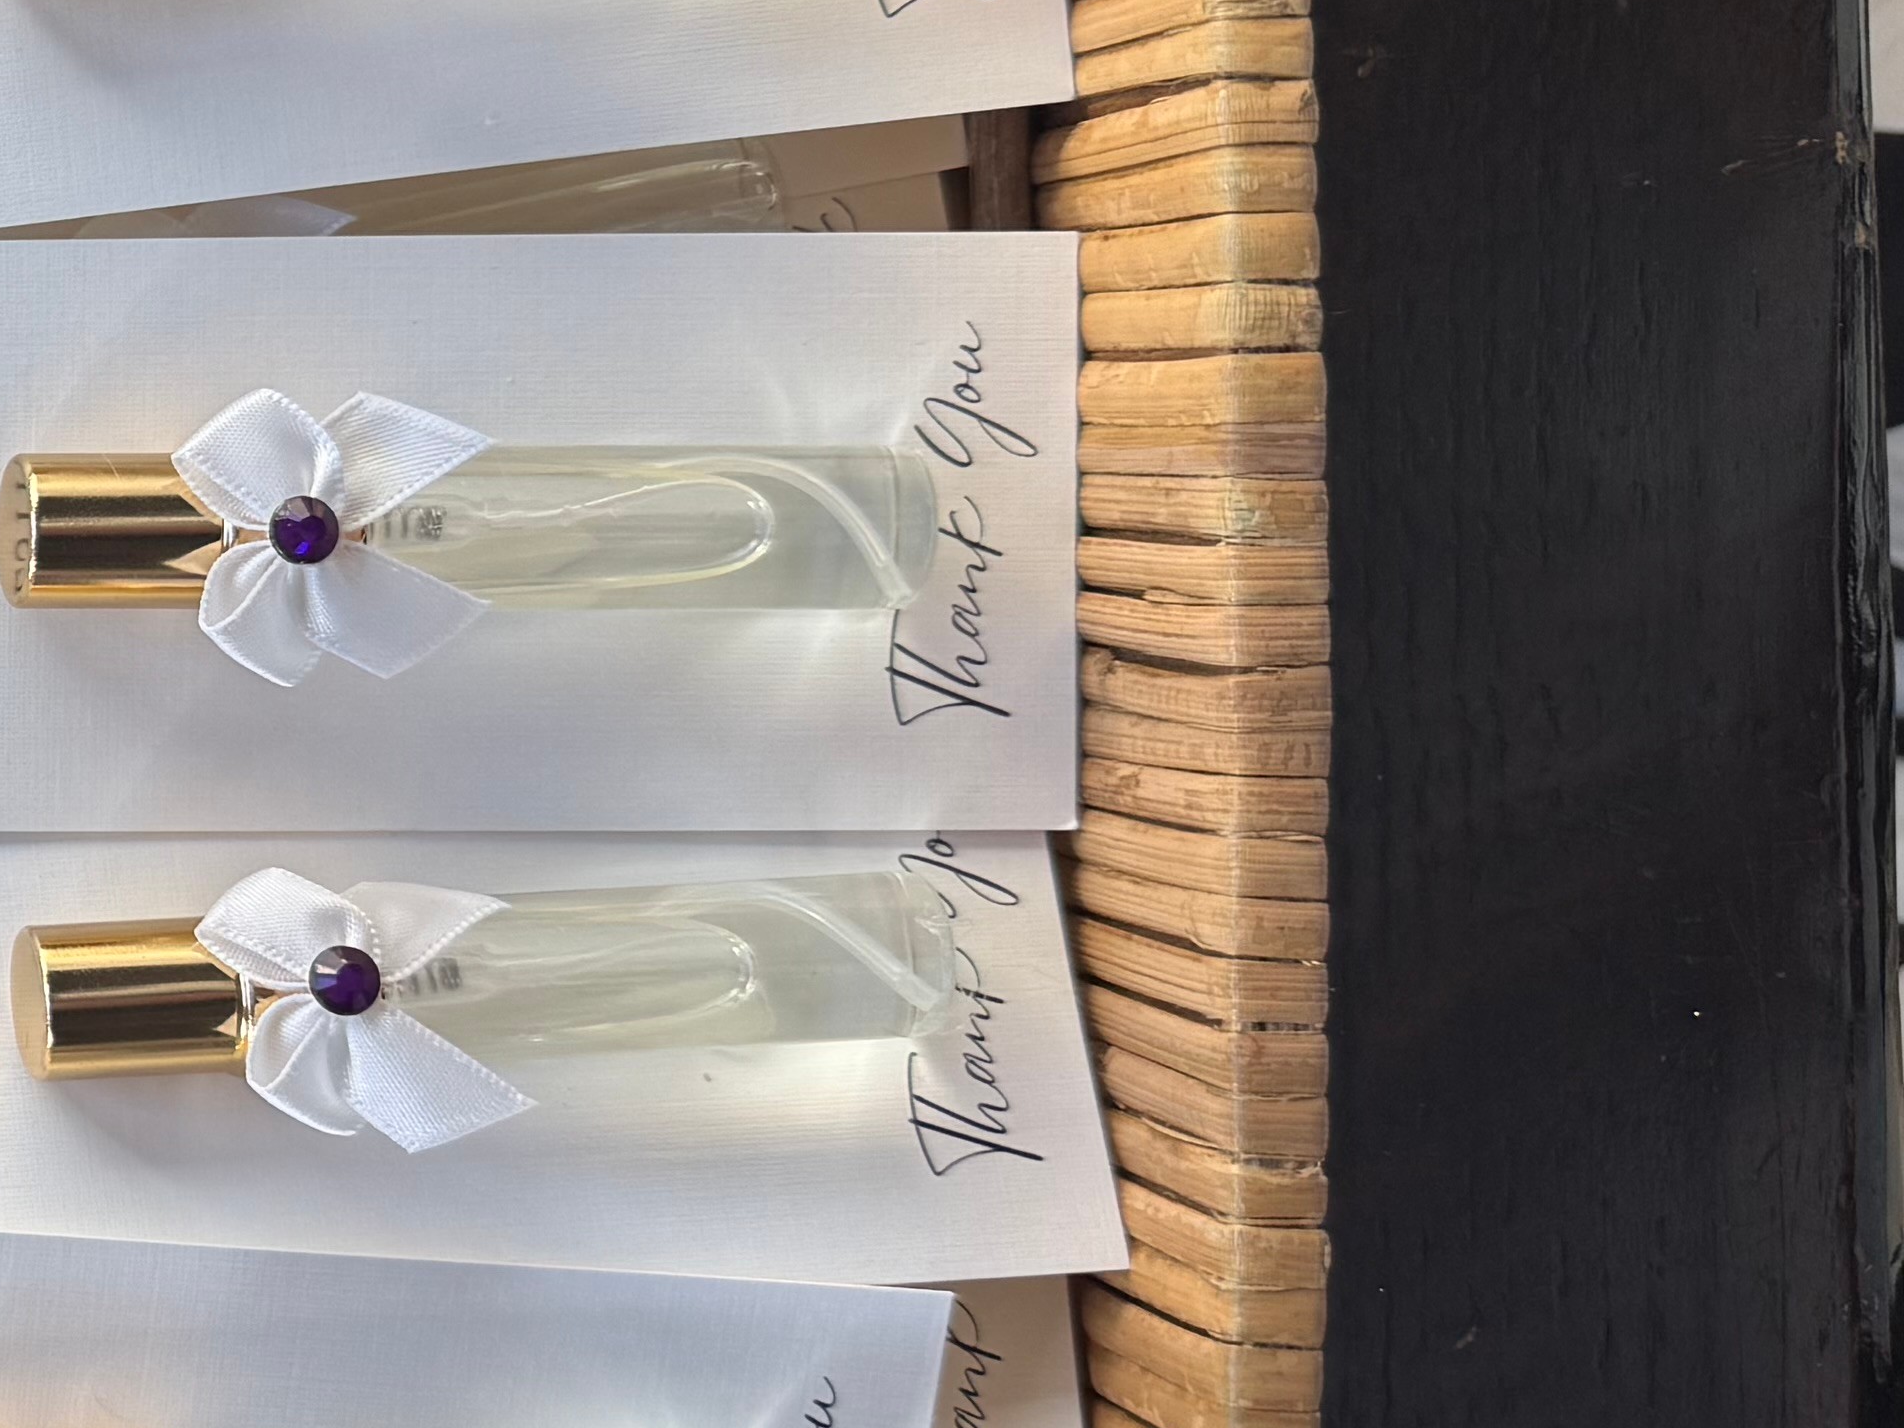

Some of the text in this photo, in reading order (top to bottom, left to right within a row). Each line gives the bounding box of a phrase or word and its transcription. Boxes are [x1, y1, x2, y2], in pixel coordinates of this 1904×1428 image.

[885, 319, 1039, 727] Thank You
[898, 828, 1020, 920] Yo
